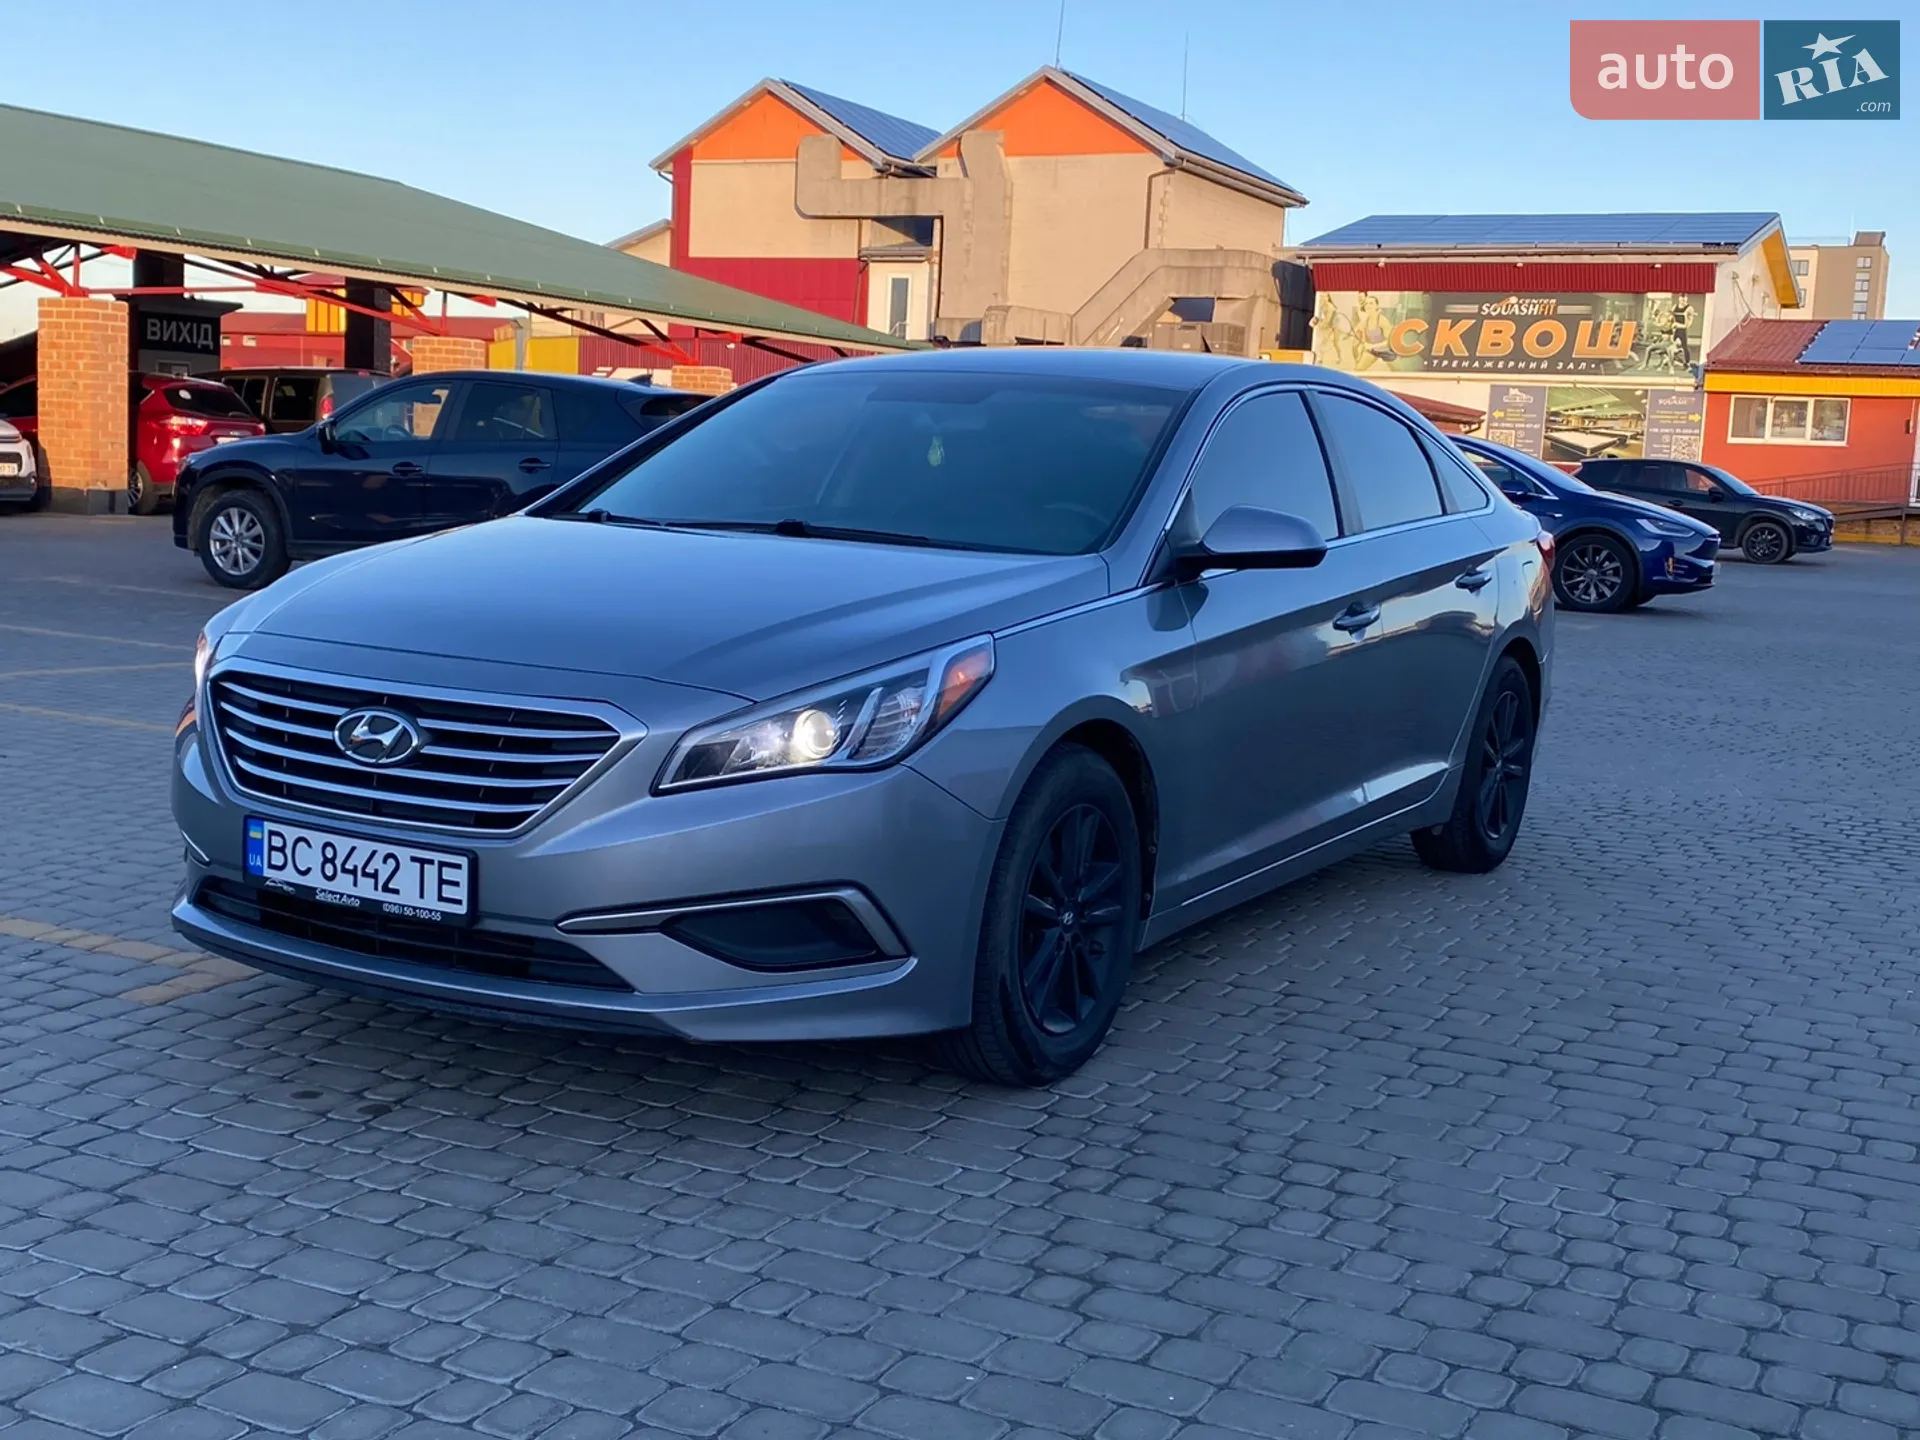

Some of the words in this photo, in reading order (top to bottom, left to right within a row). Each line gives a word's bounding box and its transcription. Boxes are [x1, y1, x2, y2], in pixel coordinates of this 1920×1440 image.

[146, 317, 214, 350] ВИХІД
[1389, 318, 1638, 360] СКВОШ
[1431, 359, 1549, 370] ТРЕНАЖЕРНИЙ
[1556, 361, 1588, 371] ЗАЛ
[249, 853, 263, 868] UA
[266, 829, 314, 877] BC
[320, 840, 401, 896] 8442
[409, 855, 464, 907] TE
[315, 887, 341, 903] Select
